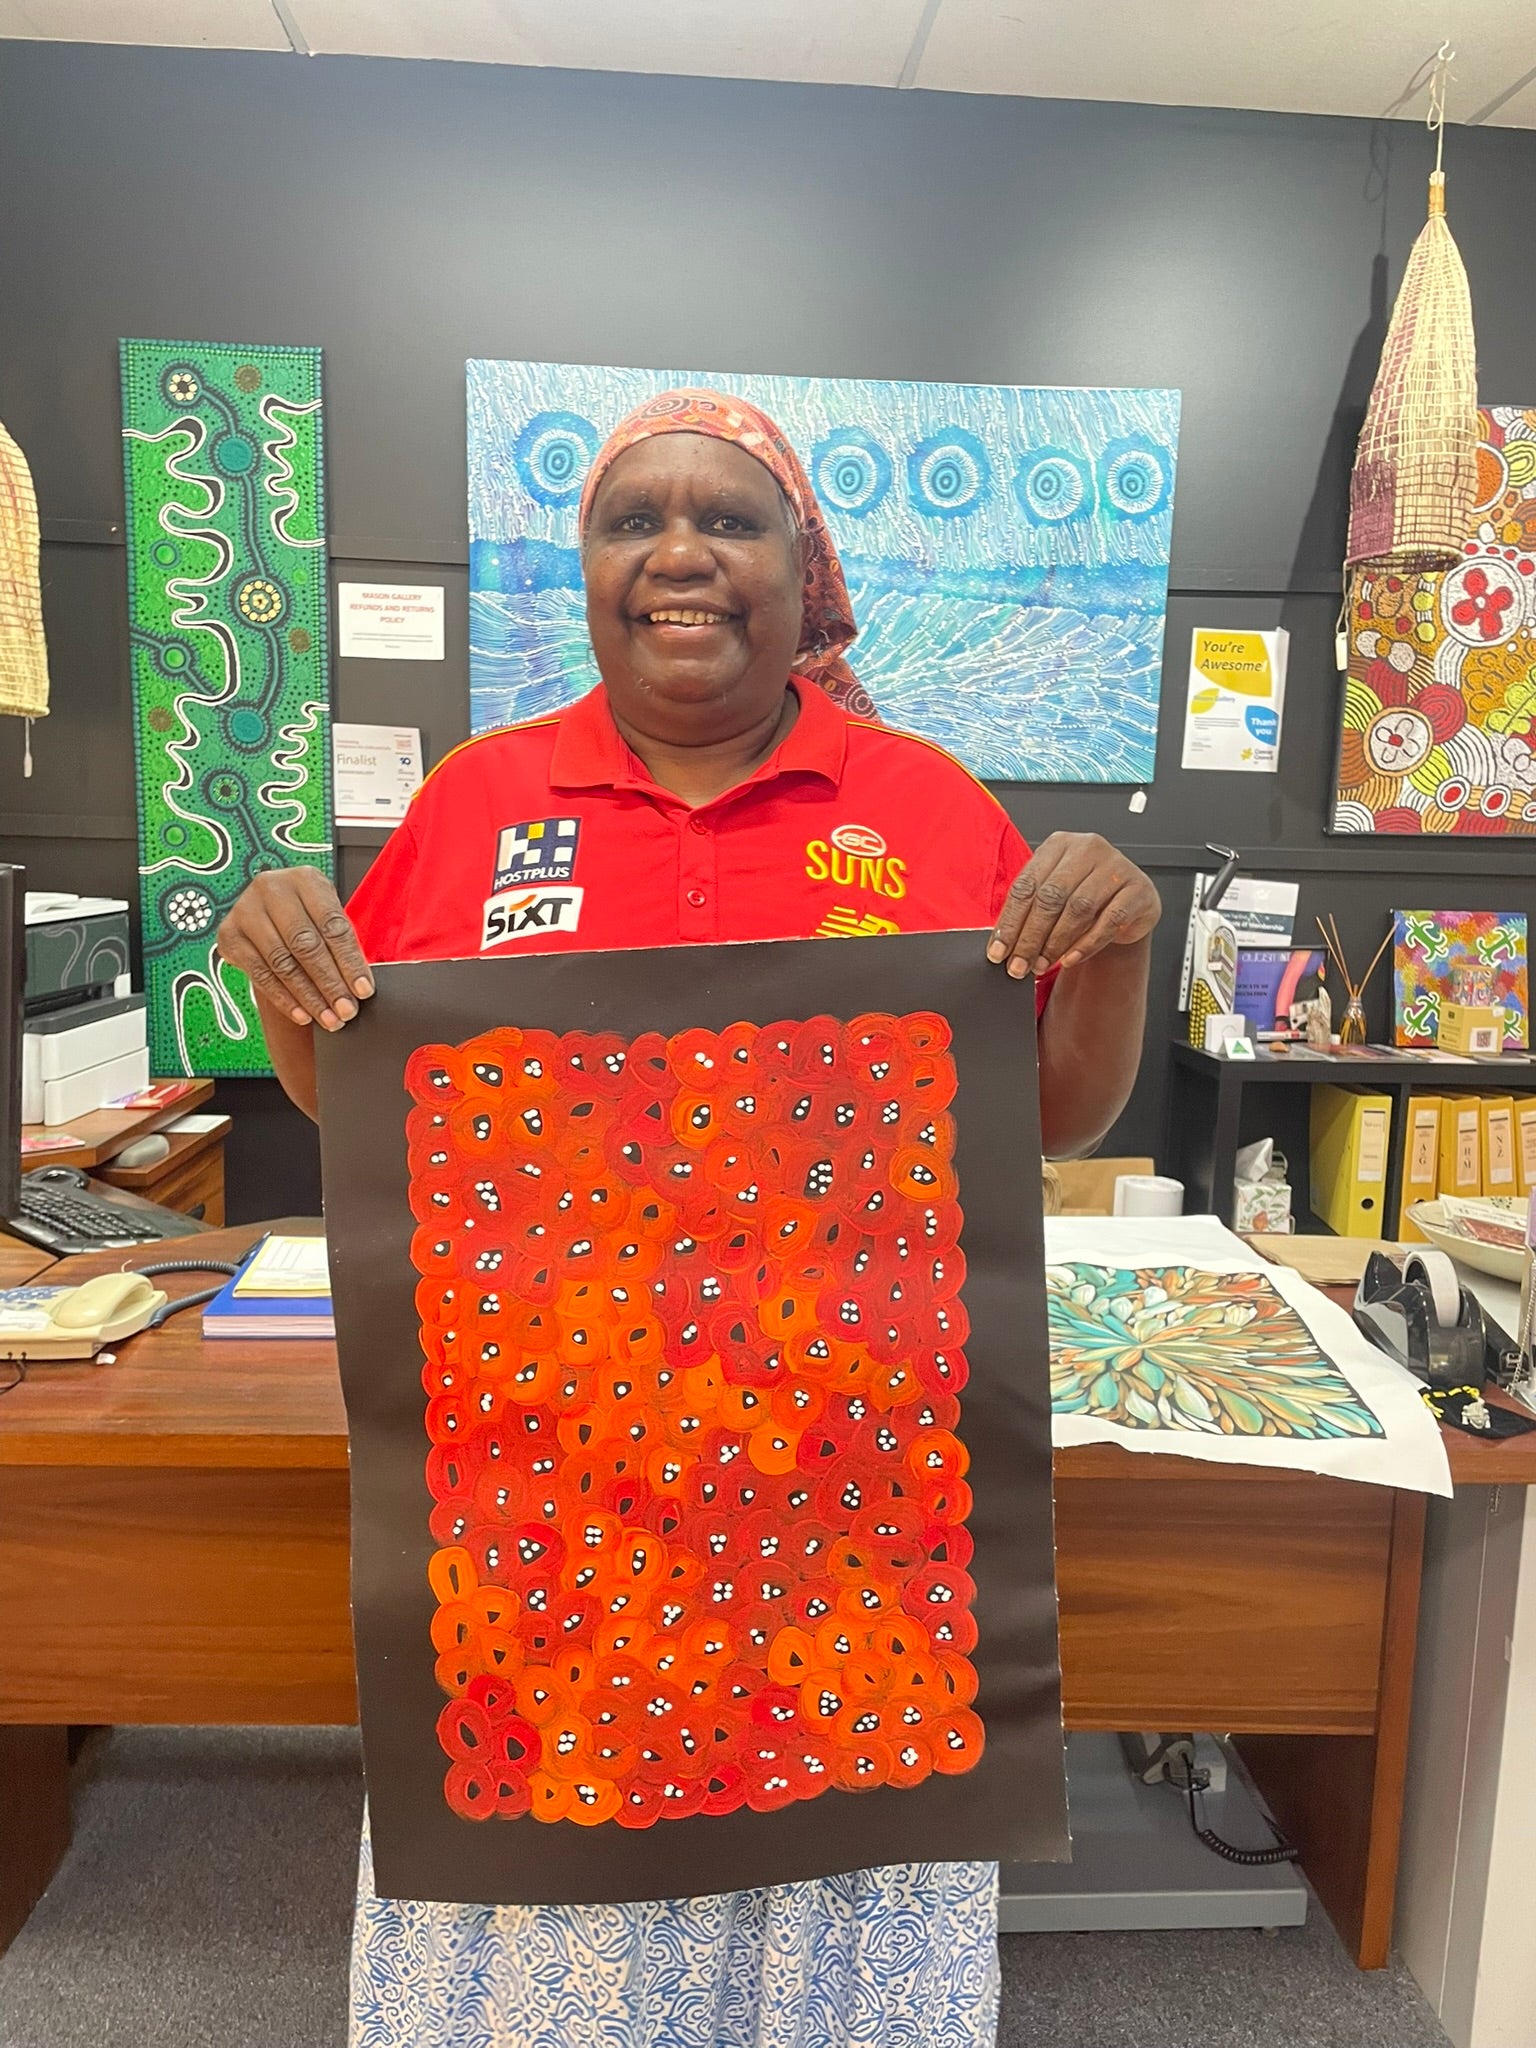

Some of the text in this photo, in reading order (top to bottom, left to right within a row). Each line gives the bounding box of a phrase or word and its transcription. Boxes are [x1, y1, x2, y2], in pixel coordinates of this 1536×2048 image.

[391, 593, 423, 601] GALLERY
[350, 603, 382, 612] REFUNDS
[380, 616, 405, 624] POLICY
[1203, 640, 1245, 654] You're
[337, 753, 377, 766] Finalist
[805, 839, 907, 900] SUNS
[493, 866, 571, 891] HOSTPLUS
